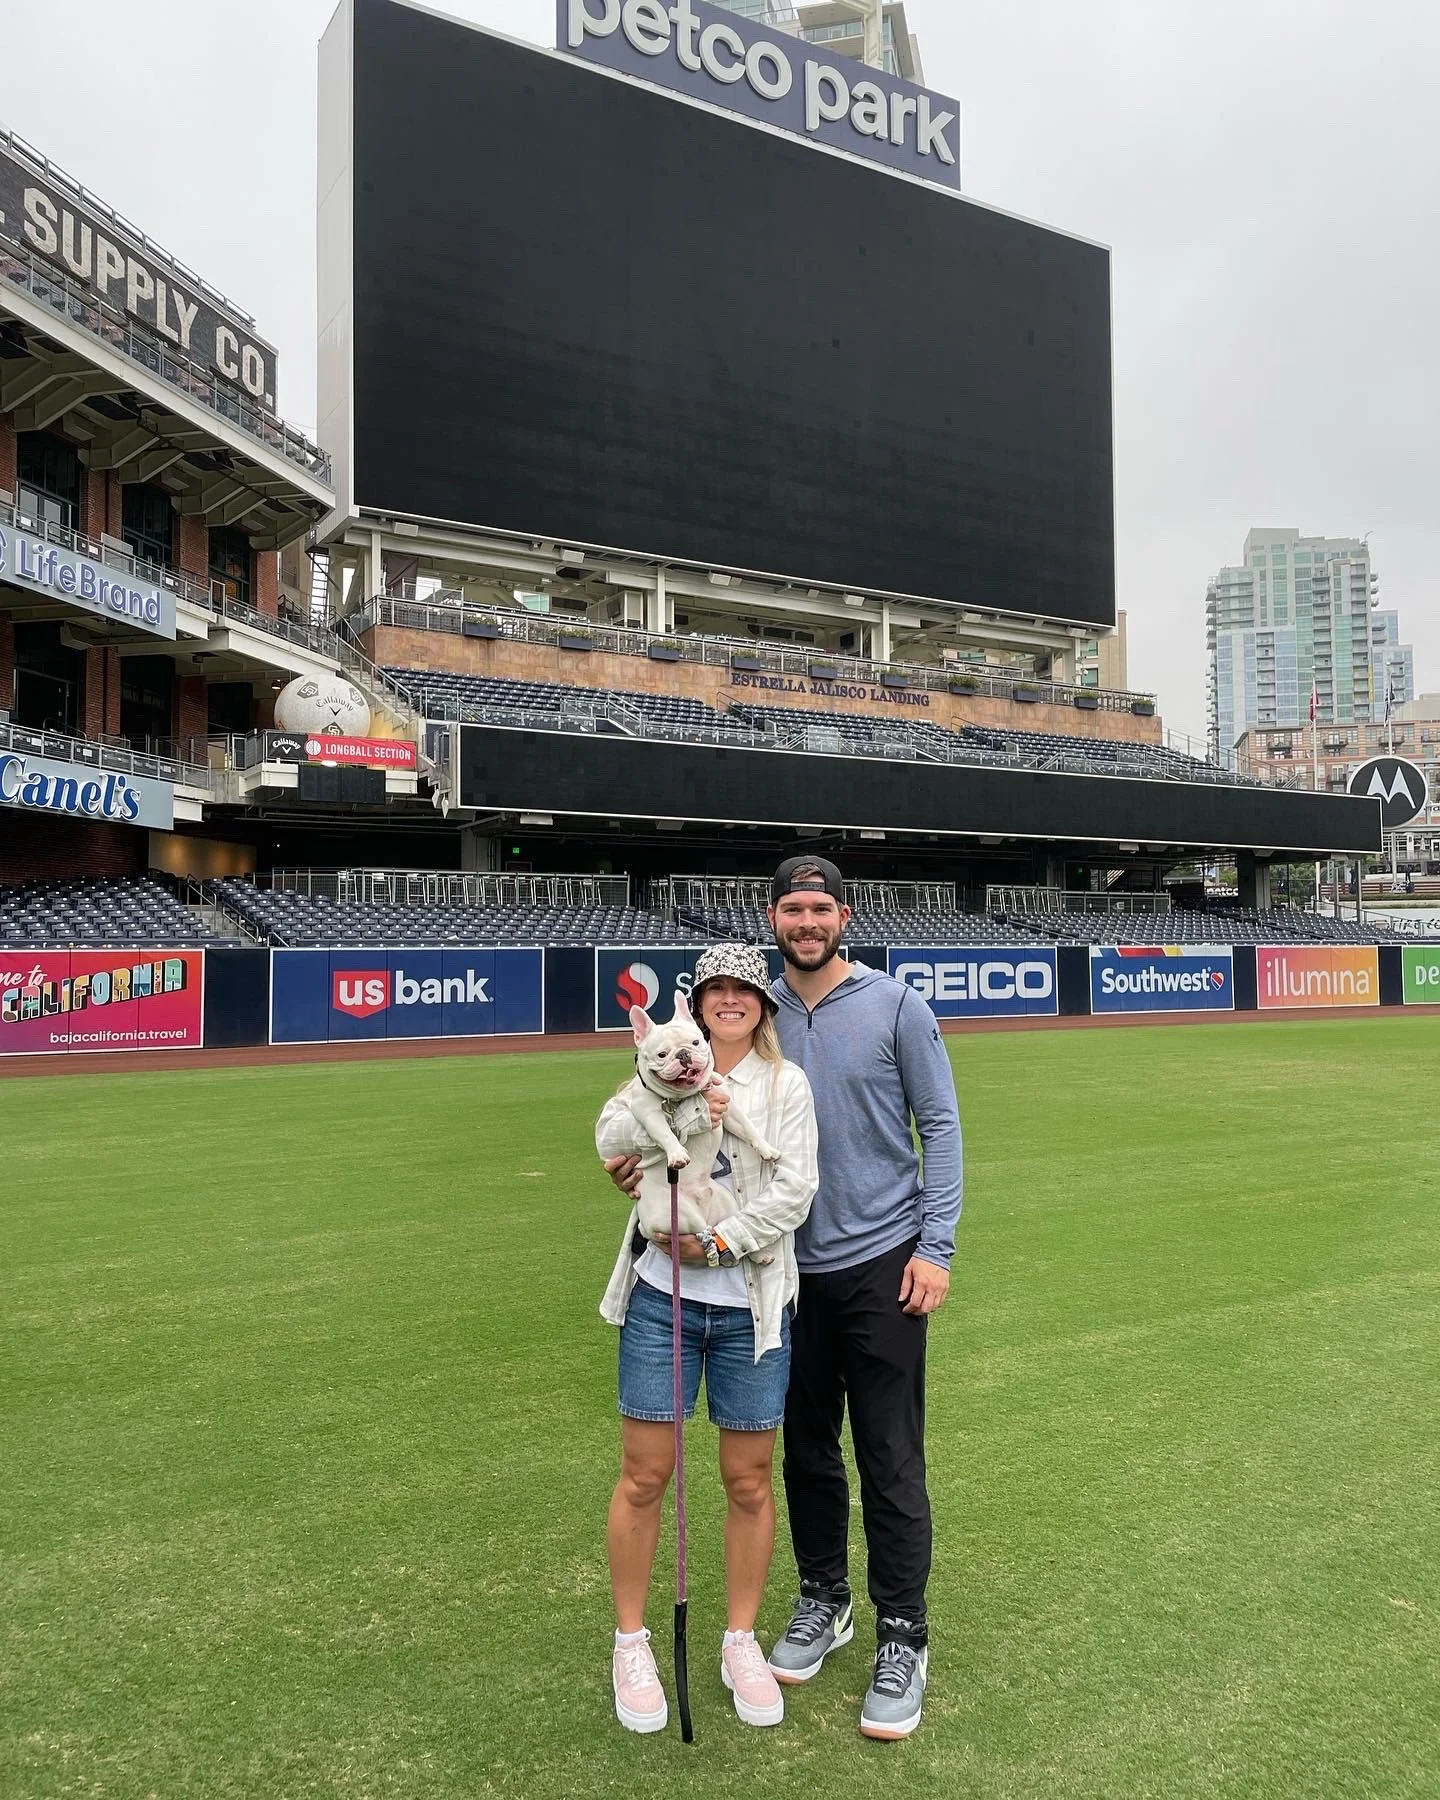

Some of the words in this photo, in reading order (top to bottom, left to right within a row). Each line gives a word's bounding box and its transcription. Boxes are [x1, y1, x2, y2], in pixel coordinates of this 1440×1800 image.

[568, 0, 793, 101] petco
[804, 59, 956, 165] park
[23, 187, 199, 350] SUPPLY
[215, 325, 274, 408] CO.
[15, 538, 162, 626] LifeBrand
[315, 695, 354, 712] Callaway
[731, 672, 807, 694] ESTRELLA
[810, 681, 867, 700] JALISCO
[870, 688, 930, 707] LANDING
[271, 737, 302, 750] Callaway
[325, 743, 372, 757] LONGBALL
[374, 747, 411, 760] SECTION
[0, 754, 140, 821] Canel's
[2, 958, 187, 1023] CALIFORNIA
[28, 964, 48, 987] to
[338, 979, 385, 1006] us
[895, 961, 1052, 1001] GEICO
[1101, 966, 1210, 994] Southwest
[1266, 958, 1370, 997] illumina
[50, 1028, 187, 1045] bajacalifornia.travel
